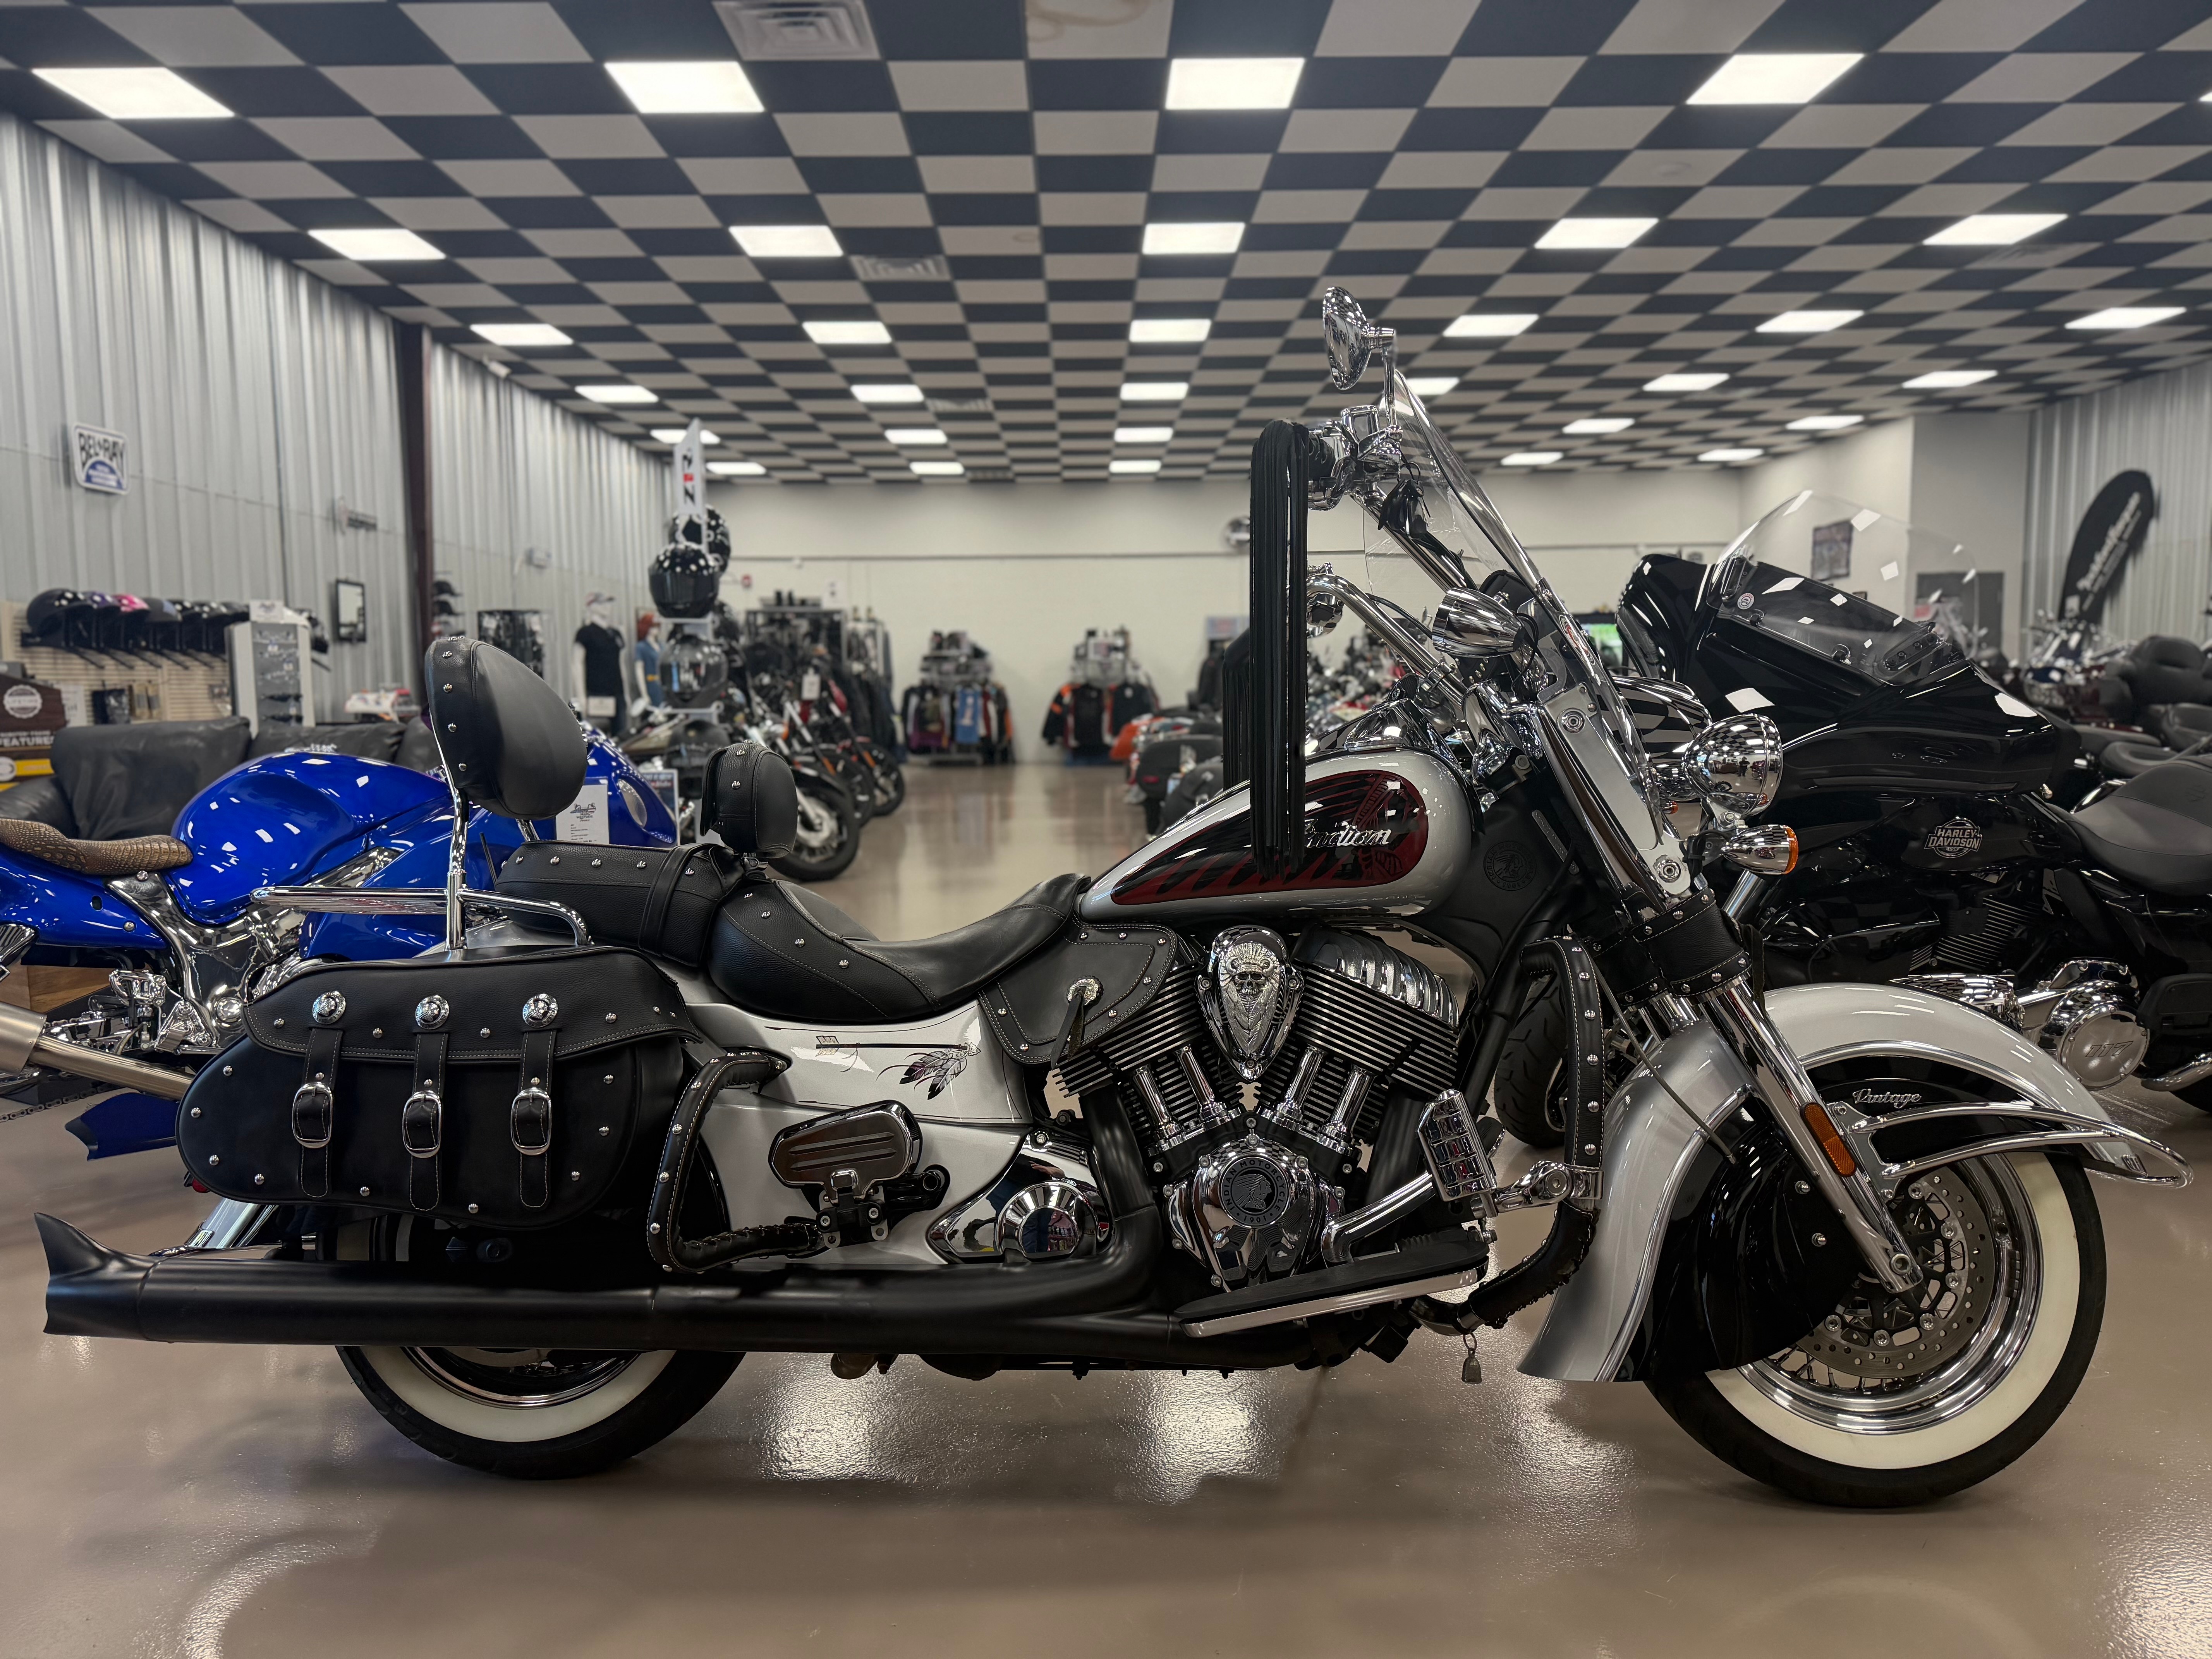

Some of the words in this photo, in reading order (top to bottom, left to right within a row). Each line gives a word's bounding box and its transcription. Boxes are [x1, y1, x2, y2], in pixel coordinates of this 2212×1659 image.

[1928, 836, 1980, 849] DAVIDSON
[2085, 1041, 2134, 1057] 117
[1852, 1089, 1922, 1109] Vintage
[1223, 1168, 1237, 1211] INDIAN
[1240, 1159, 1285, 1211] MOTORCYCLE
